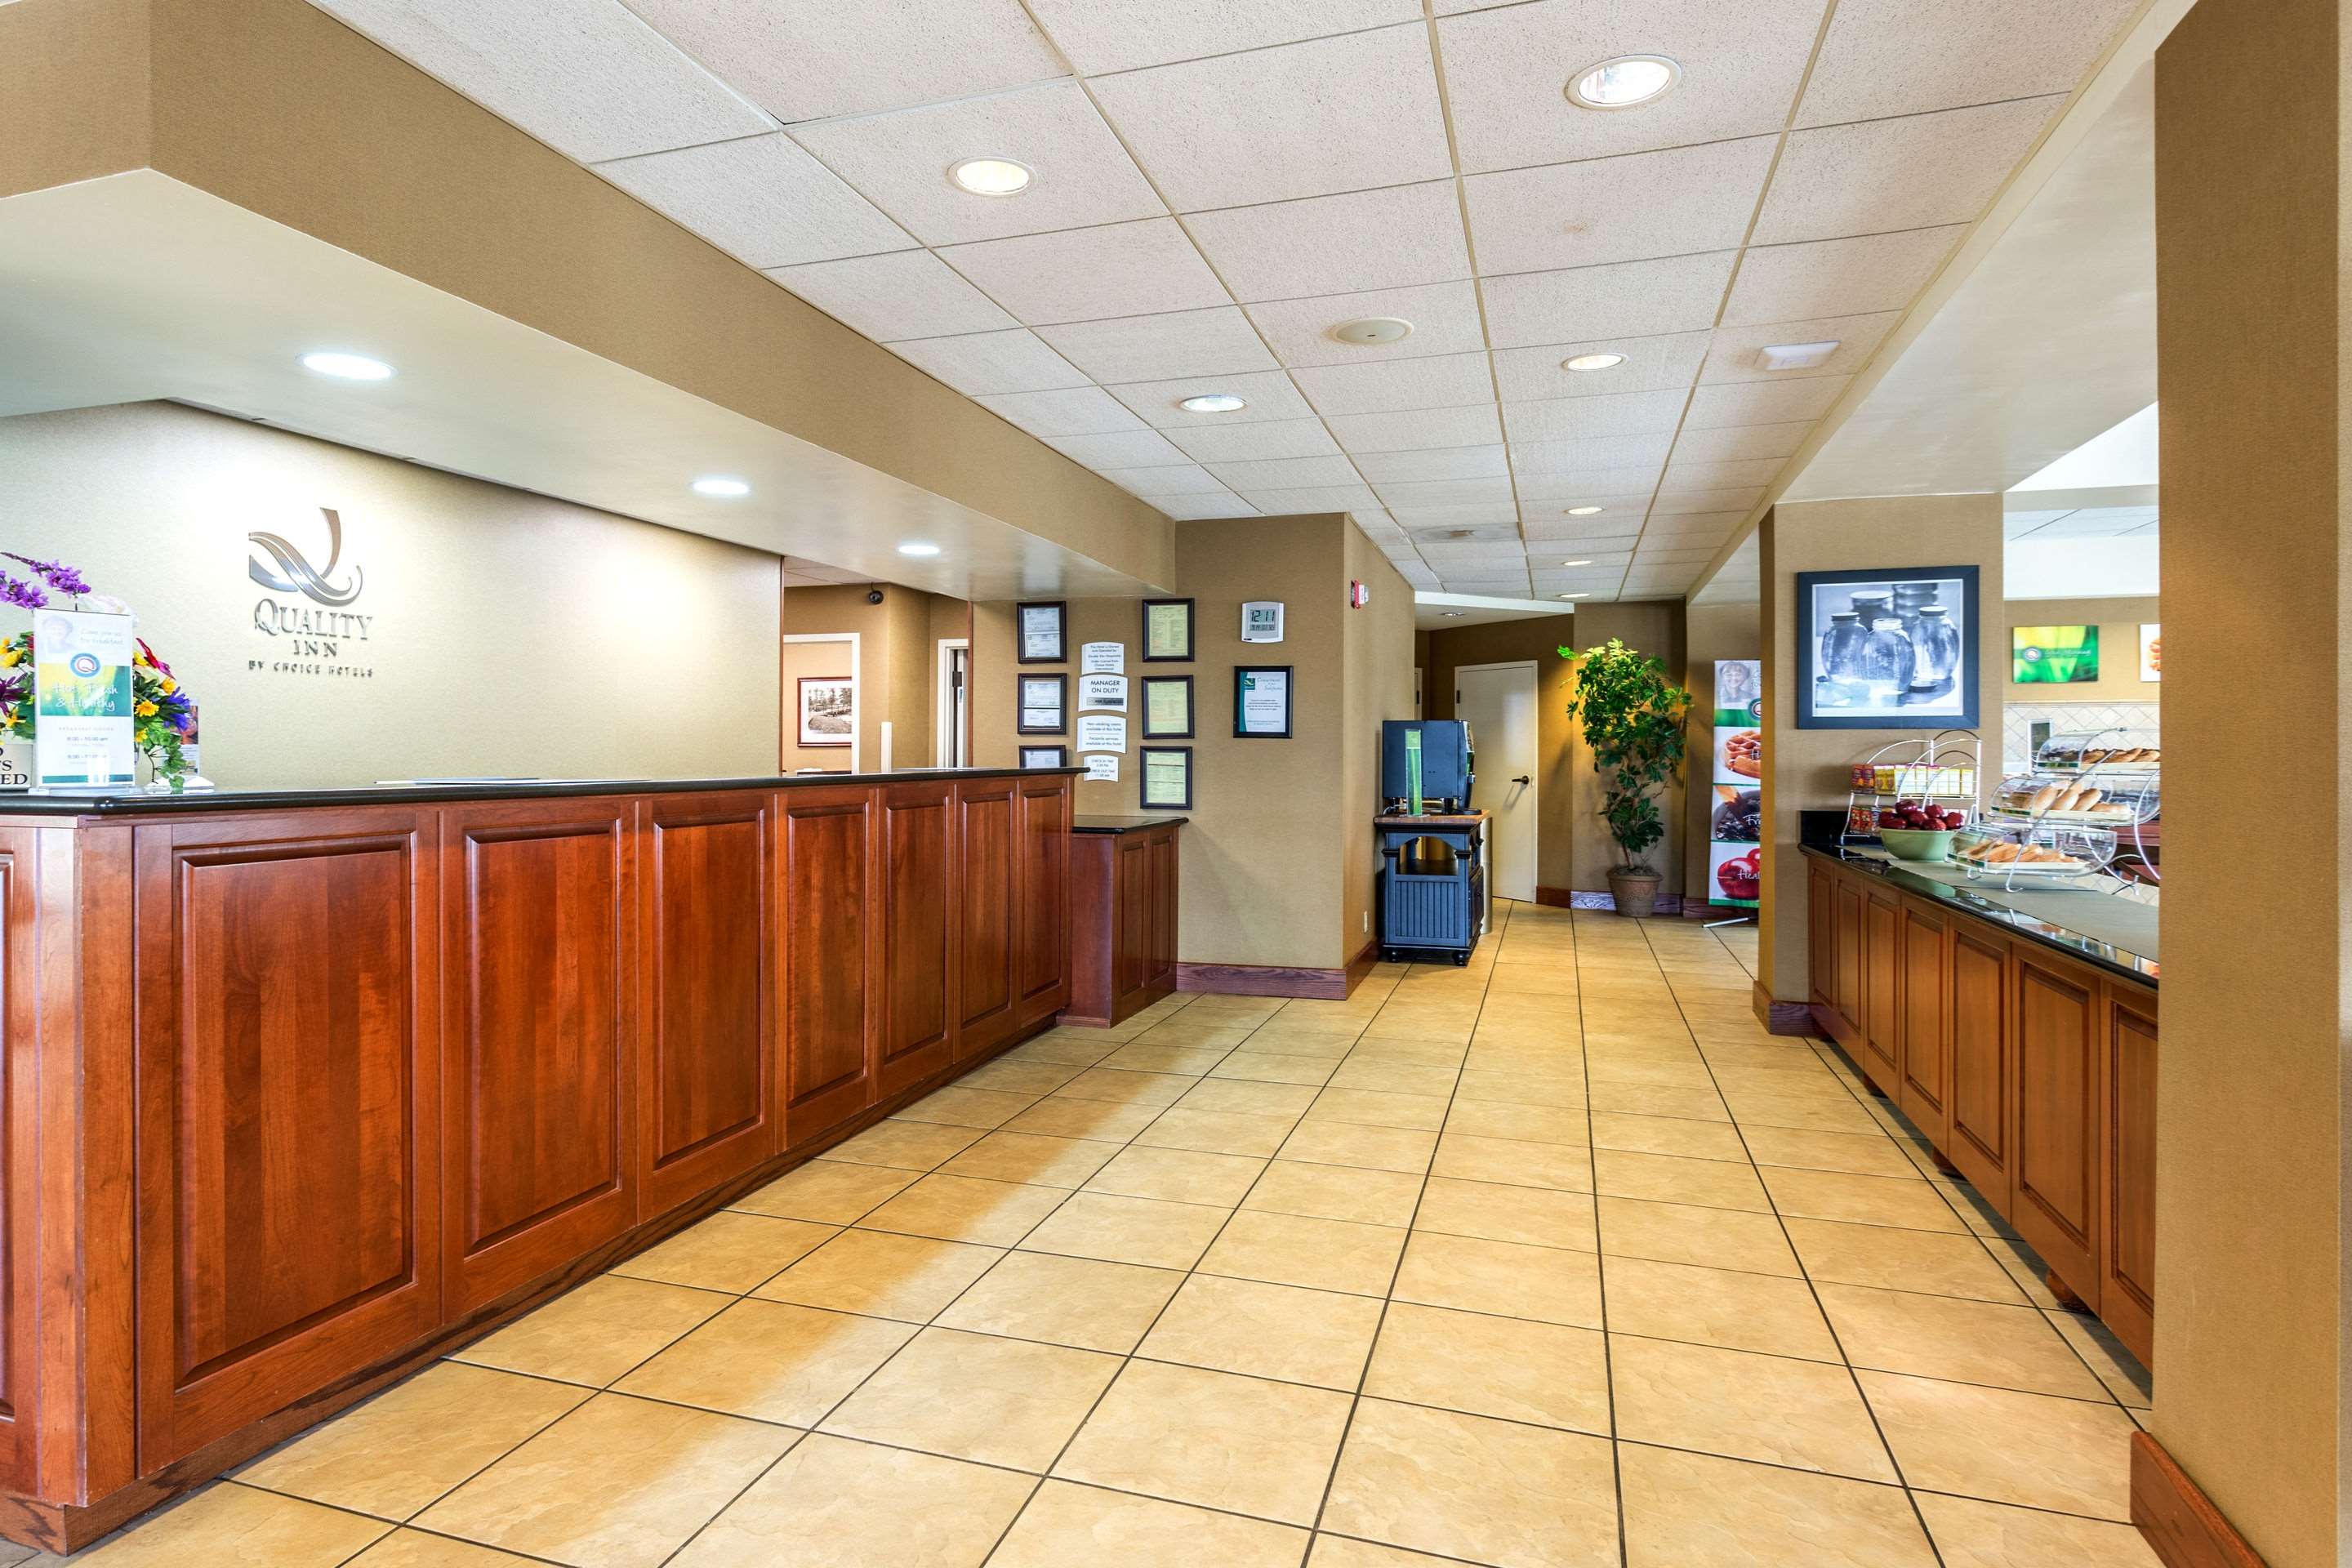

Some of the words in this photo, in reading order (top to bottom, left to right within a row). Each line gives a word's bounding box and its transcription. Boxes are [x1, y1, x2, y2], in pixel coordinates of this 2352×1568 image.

[254, 598, 373, 640] QUALITY
[293, 639, 338, 657] INN
[248, 660, 265, 670] BY
[274, 662, 321, 675] CHOICE
[327, 665, 373, 679] HOTELS
[71, 697, 116, 712] Helthy
[0, 760, 12, 771] S
